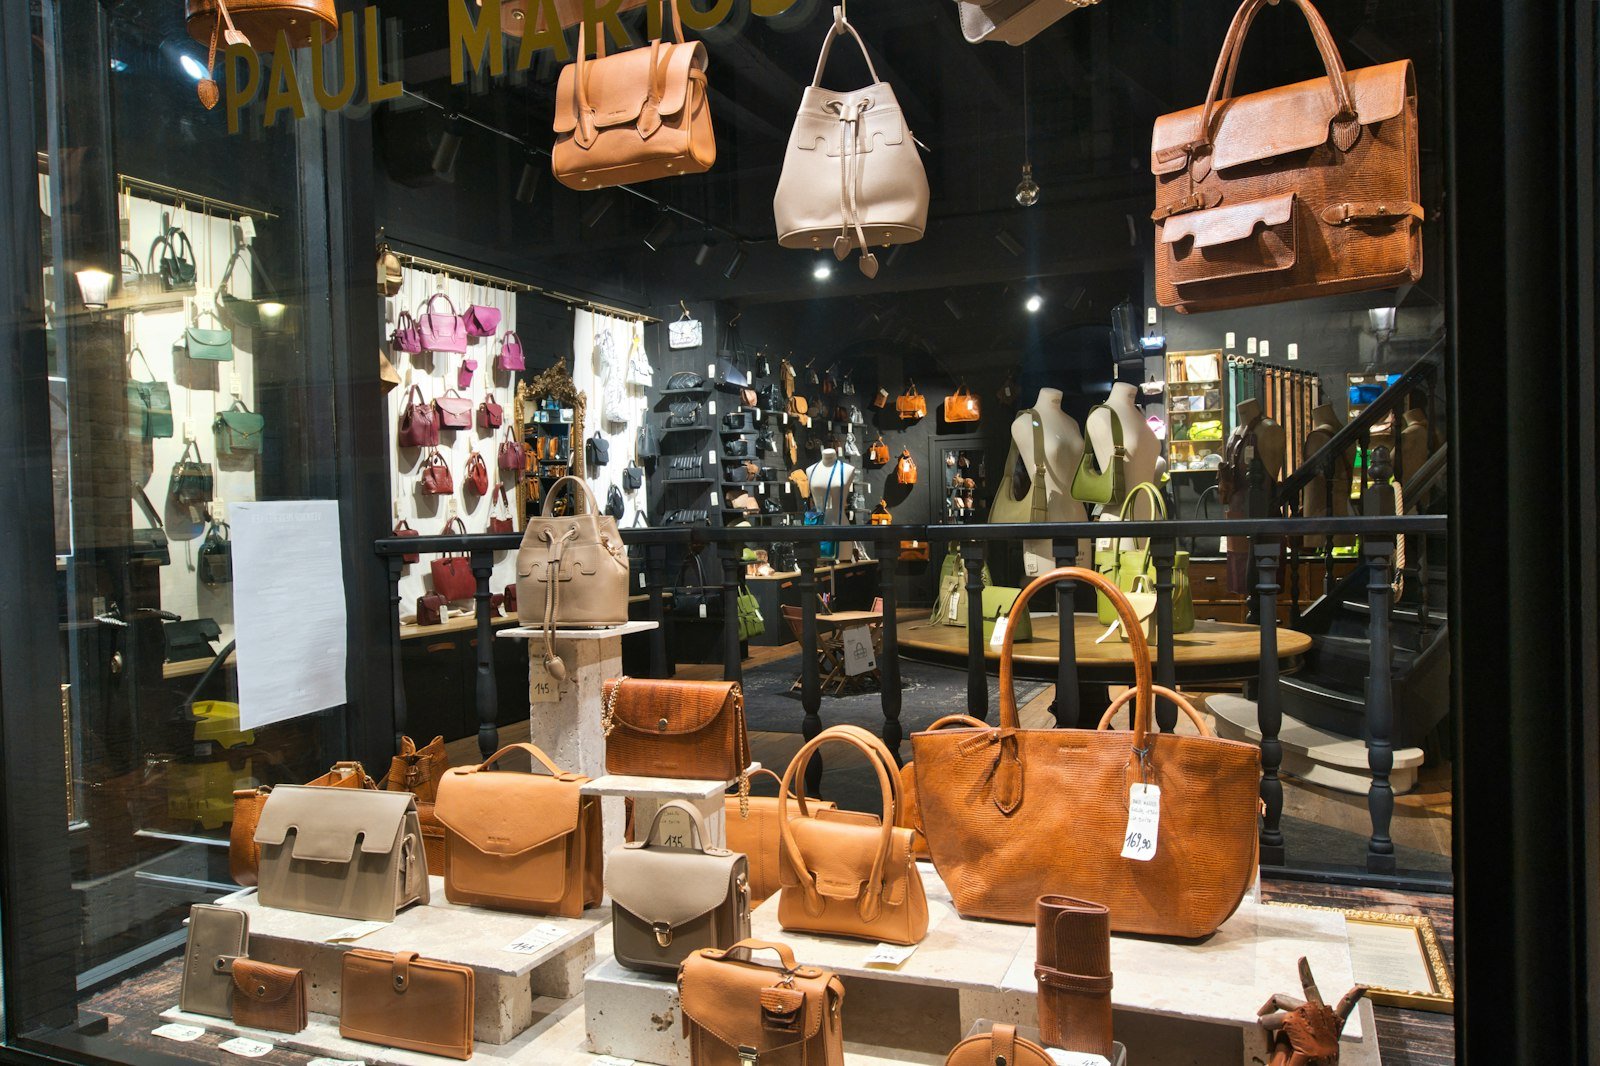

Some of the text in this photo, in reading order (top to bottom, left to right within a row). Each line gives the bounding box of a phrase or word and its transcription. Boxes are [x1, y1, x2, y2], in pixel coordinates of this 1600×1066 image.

[225, 0, 794, 134] PAUL MAR
[534, 682, 550, 695] 145
[664, 834, 684, 847] 135
[1126, 832, 1152, 853] 169,90
